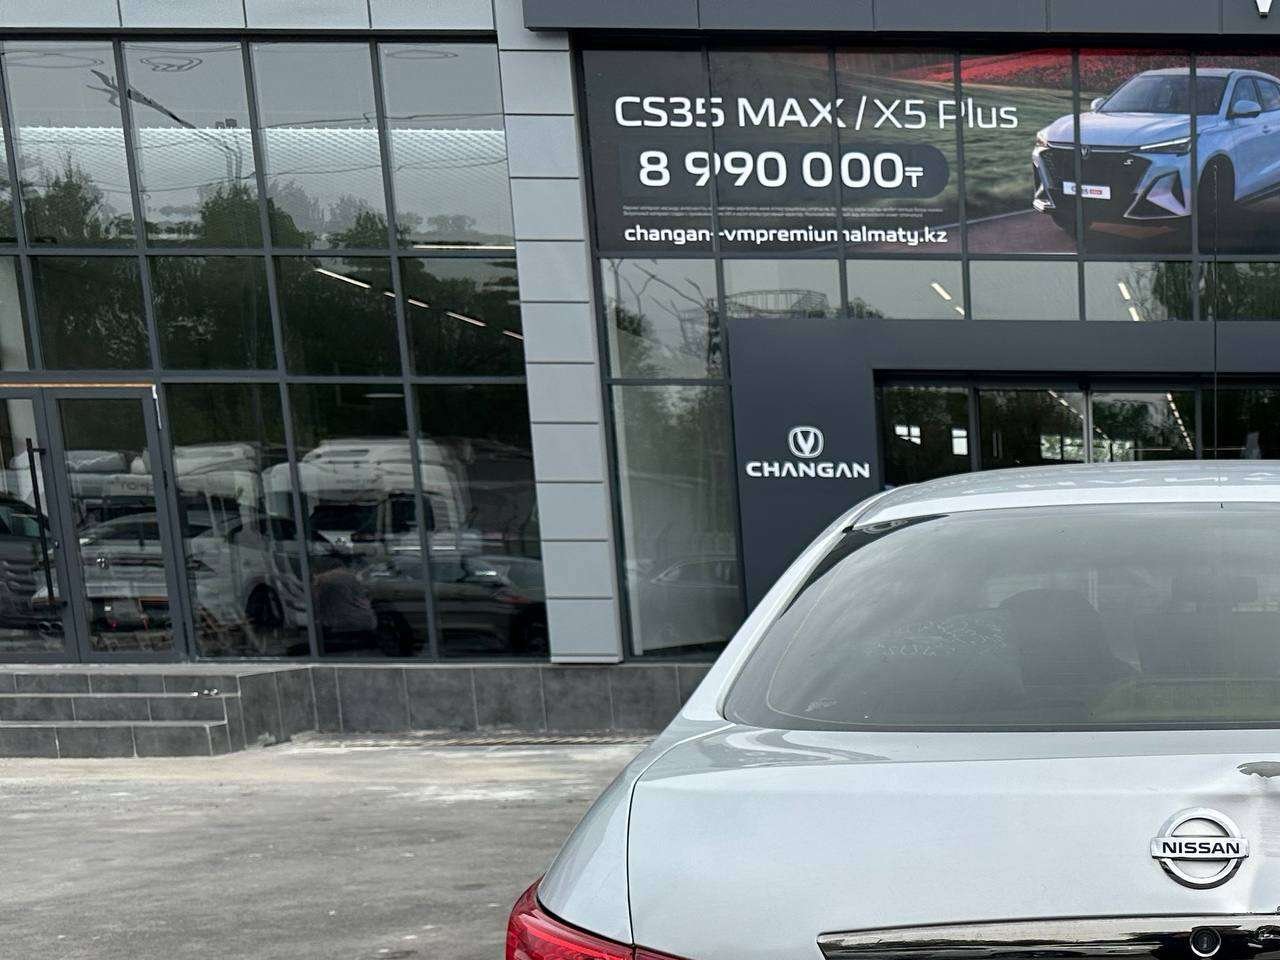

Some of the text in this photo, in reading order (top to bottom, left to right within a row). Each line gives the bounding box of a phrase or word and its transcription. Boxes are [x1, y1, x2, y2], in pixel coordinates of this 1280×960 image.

[615, 96, 724, 128] CS35
[738, 97, 847, 128] MAX
[938, 97, 1018, 129] Plus
[639, 150, 671, 187] 8
[684, 150, 787, 188] 990
[745, 462, 870, 478] CHANGAN
[1162, 842, 1239, 854] NISSAN
